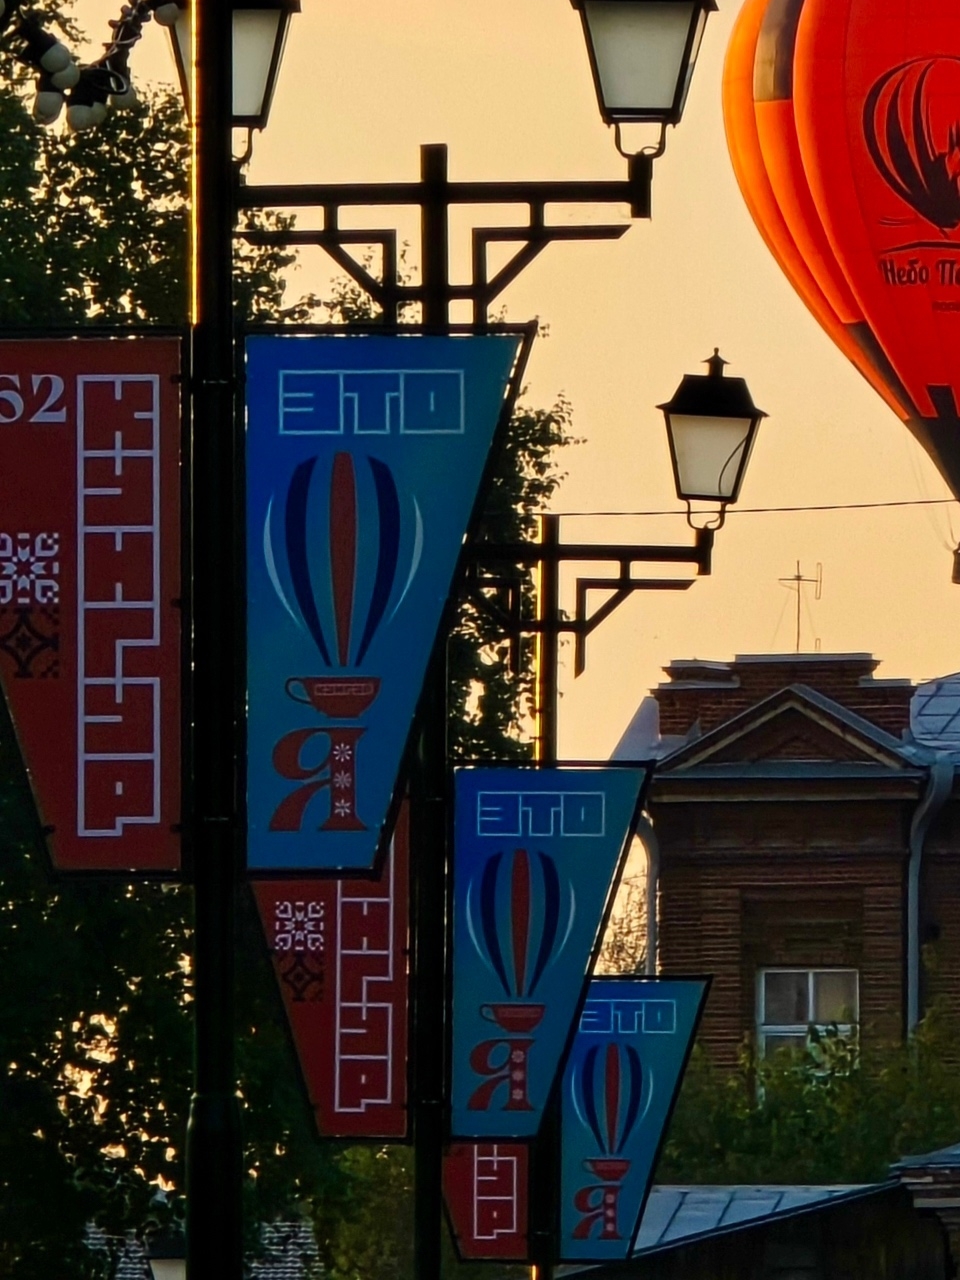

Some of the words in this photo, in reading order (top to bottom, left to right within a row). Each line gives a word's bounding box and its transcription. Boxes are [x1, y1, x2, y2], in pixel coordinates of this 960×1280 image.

[879, 257, 930, 286] Небо
[279, 369, 465, 435] ЭТО
[77, 374, 160, 837] КУНГУР
[269, 727, 368, 831] Я
[478, 791, 606, 837] ЭТО
[335, 877, 393, 1113] НГУР
[579, 999, 676, 1034] ЭТО
[467, 1038, 535, 1111] Я
[572, 1185, 623, 1240] Я
